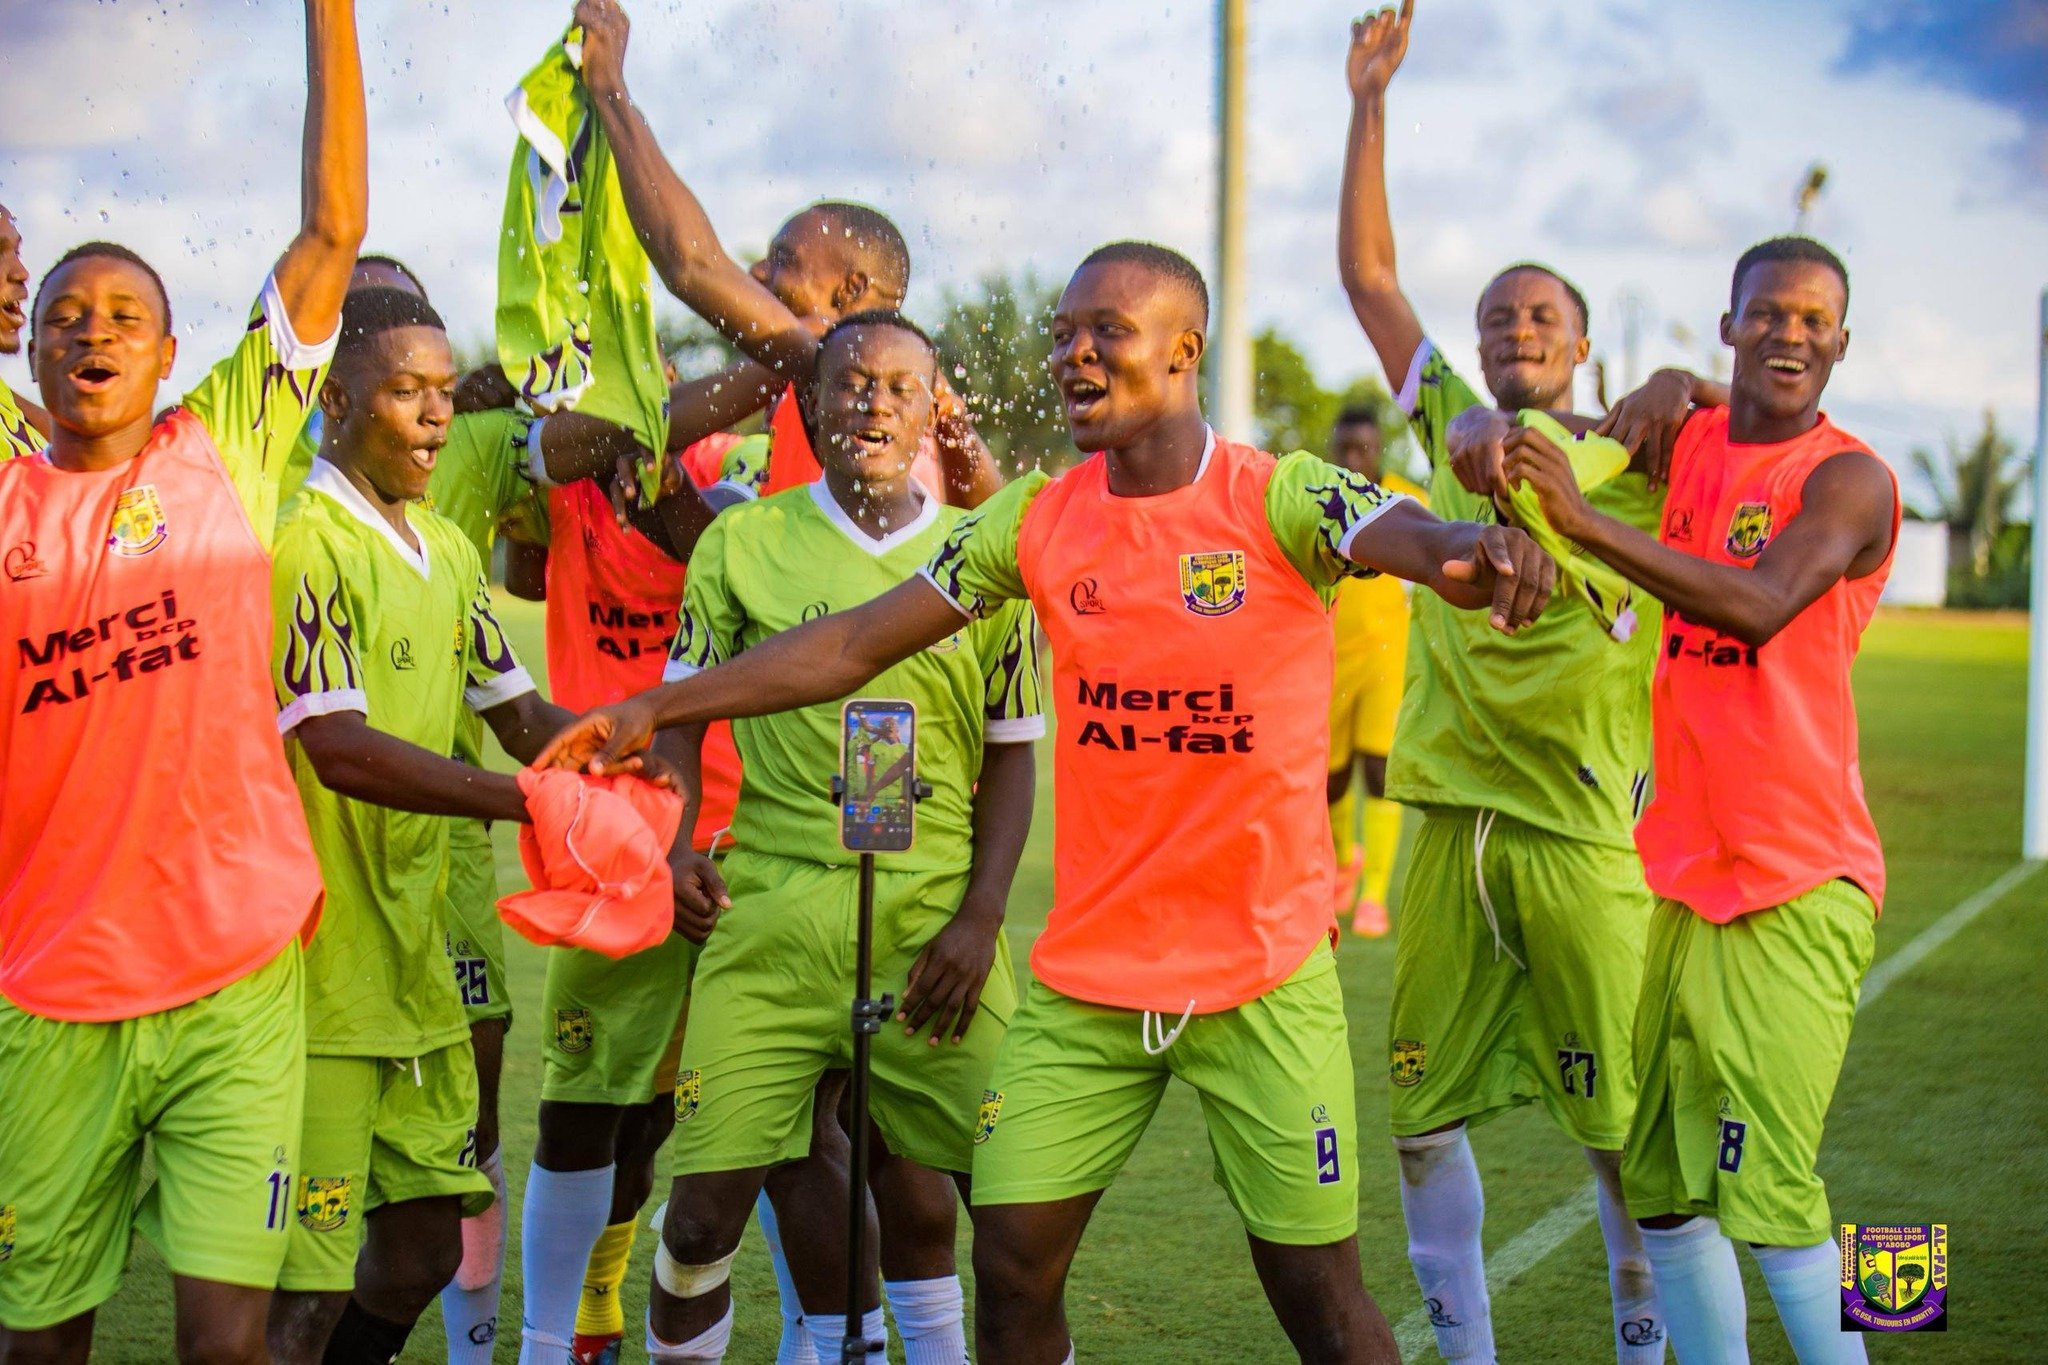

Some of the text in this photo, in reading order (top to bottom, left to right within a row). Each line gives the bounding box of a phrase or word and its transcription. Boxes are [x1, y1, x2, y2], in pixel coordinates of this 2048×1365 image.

[18, 590, 178, 669] Merci
[135, 619, 197, 643] bcp
[589, 602, 682, 628] Mer
[20, 632, 201, 715] Al-fat
[1078, 676, 1234, 712] Merci
[1077, 720, 1255, 755] Al-fat
[1191, 713, 1255, 726] bcp
[454, 957, 491, 1006] 25
[1557, 1047, 1598, 1099] 27
[1313, 1126, 1341, 1185] 9
[266, 1169, 291, 1232] 11
